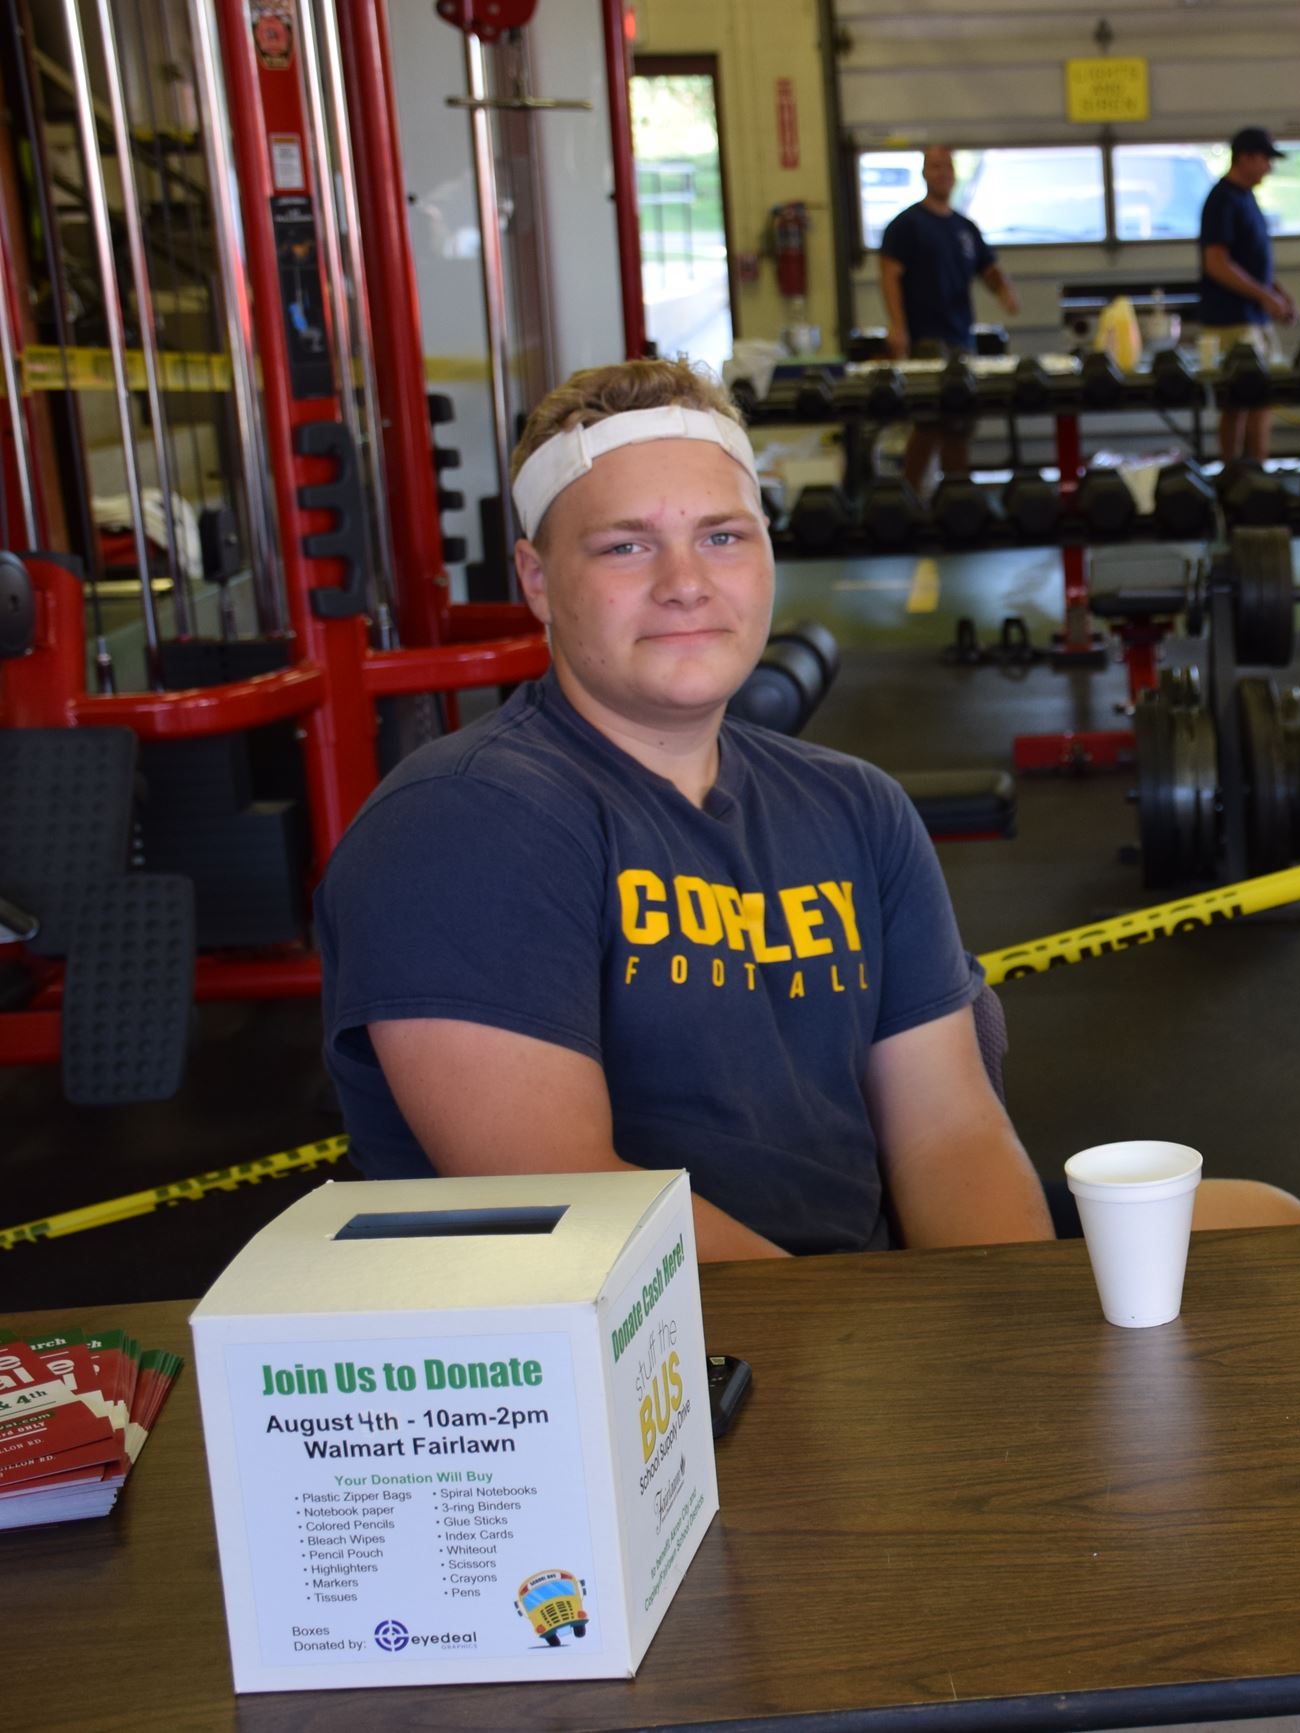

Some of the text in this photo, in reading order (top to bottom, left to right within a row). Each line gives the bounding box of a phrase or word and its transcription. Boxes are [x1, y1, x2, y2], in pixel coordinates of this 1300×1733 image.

[617, 869, 862, 963] COPLEY
[625, 954, 868, 999] FOOTALL
[611, 1233, 685, 1363] Donate Cash Here!
[634, 1319, 677, 1401] stuff the
[262, 1358, 543, 1395] Join Us to Donate
[640, 1351, 683, 1464] BUS
[266, 1414, 354, 1437] August
[358, 1411, 399, 1432] 4th
[423, 1407, 549, 1429] 10am-2pm
[304, 1436, 516, 1459] Walmart Fairlawn
[640, 1450, 660, 1496] School
[660, 1421, 678, 1461] Supply
[677, 1399, 690, 1429] Drive
[334, 1471, 493, 1486] Your Donation Will Buy
[302, 1490, 412, 1503] Plastic Zipper Bags
[440, 1485, 538, 1500] Spiral Notebooks
[304, 1507, 394, 1517] Notebook paper
[442, 1501, 521, 1514] 3-ring Binders
[306, 1520, 395, 1531] Colored Pencils
[443, 1515, 508, 1527] Glue Sticks
[307, 1535, 385, 1546] Bleach Wipes
[445, 1529, 514, 1541] Index Cards
[309, 1548, 384, 1560] Pencil Pouch
[447, 1545, 497, 1555] Whiteout
[311, 1563, 378, 1576] Highlighters
[449, 1559, 497, 1570] Scissors
[313, 1578, 359, 1588] Markers
[450, 1573, 497, 1585] Crayons
[315, 1592, 358, 1603] Tissues
[452, 1587, 481, 1598] Pens
[292, 1625, 330, 1637] Boxes
[294, 1631, 478, 1652] Donated by: eyedeal
